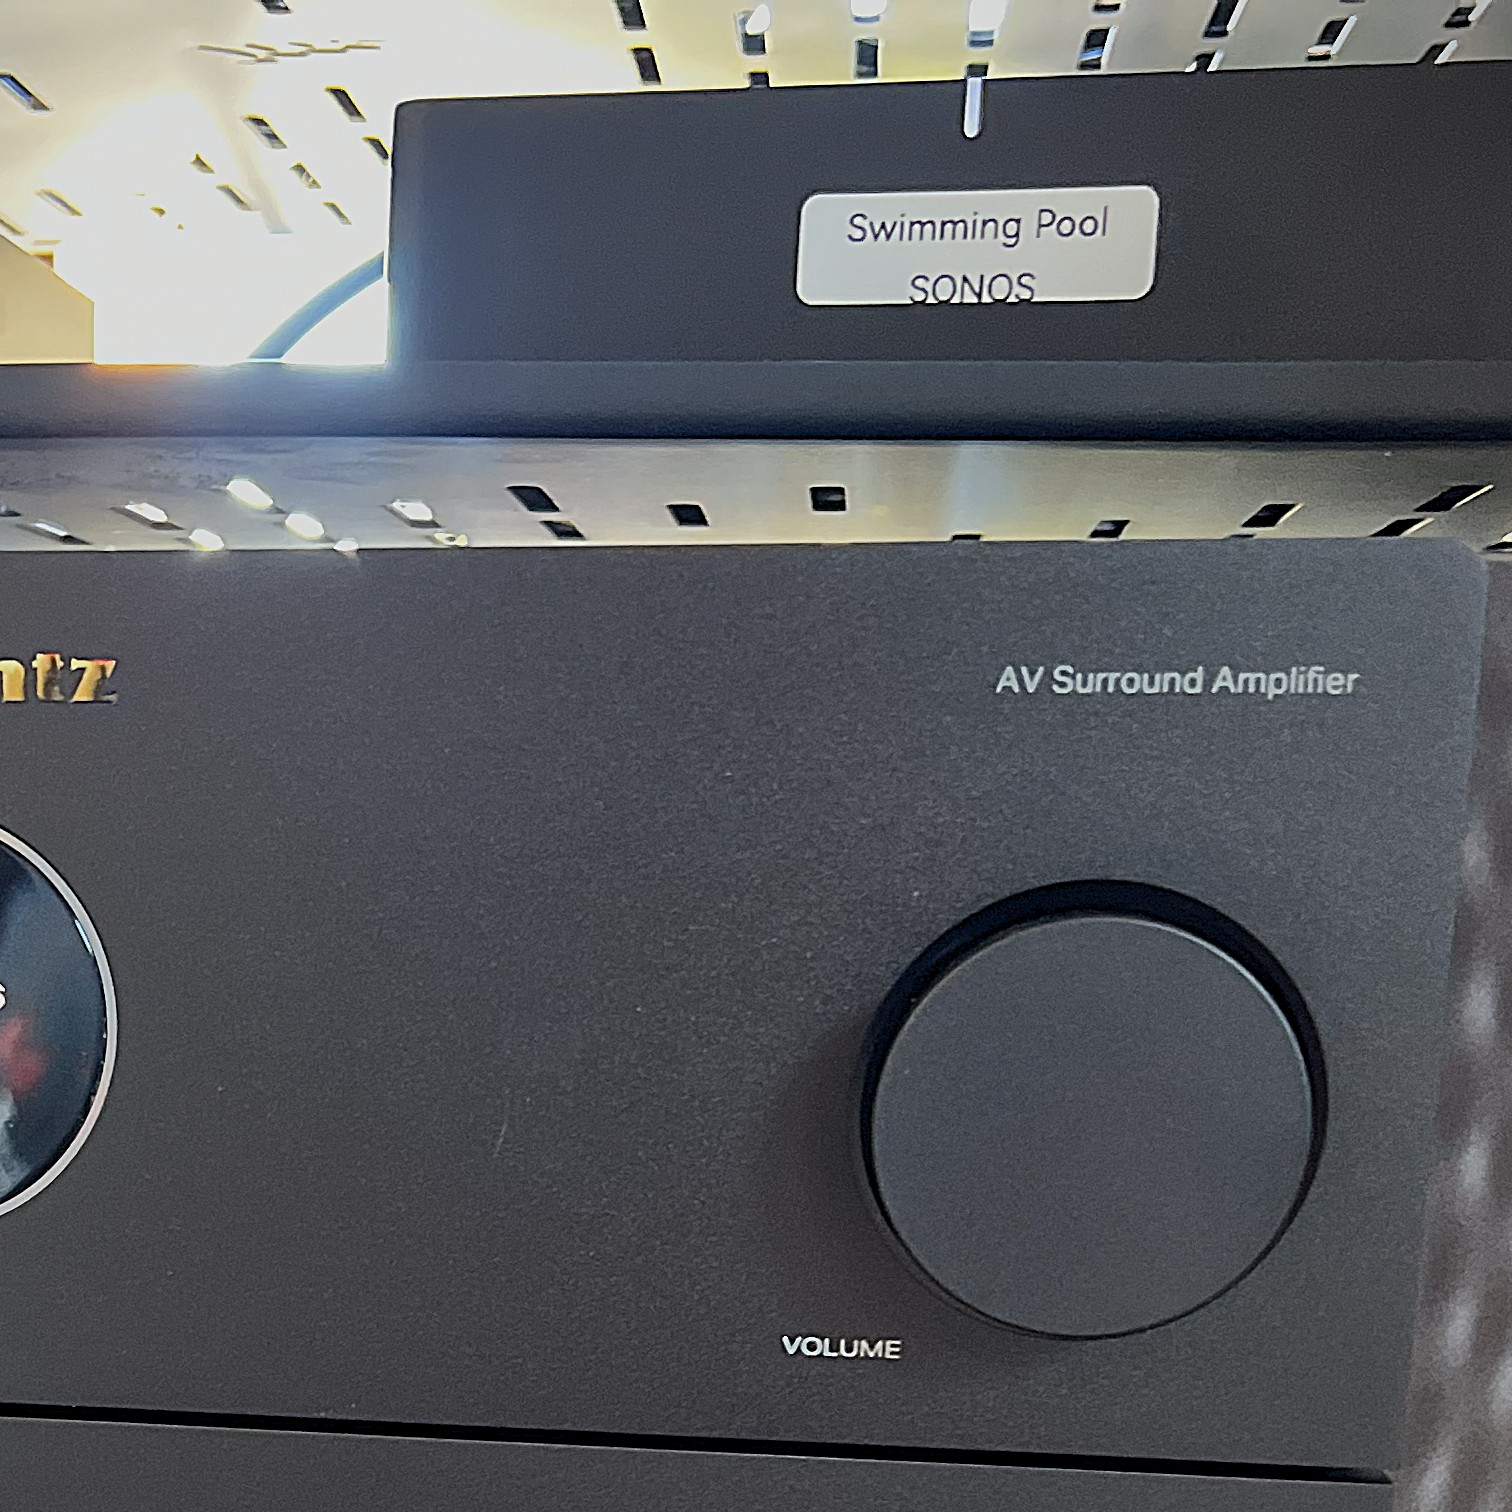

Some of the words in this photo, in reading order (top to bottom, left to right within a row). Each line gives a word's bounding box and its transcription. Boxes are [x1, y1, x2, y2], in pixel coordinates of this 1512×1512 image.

[847, 211, 1022, 248] Swimming
[1036, 205, 1109, 239] Pool
[909, 272, 1037, 304] SONOS
[995, 665, 1045, 694] AV
[1051, 664, 1204, 696] Surround
[1210, 665, 1361, 700] Amplifier
[781, 1335, 902, 1359] VOLUME
